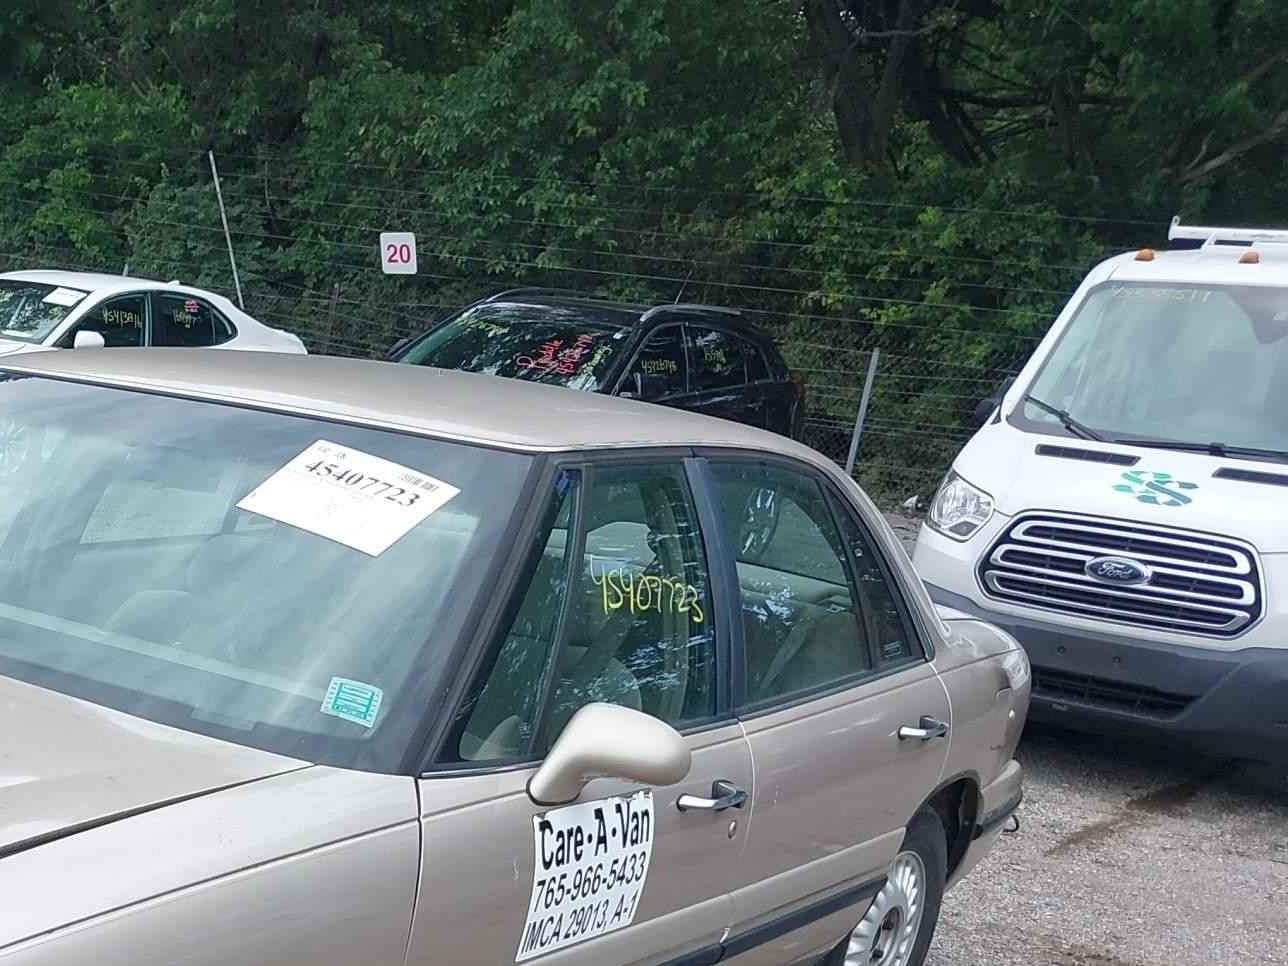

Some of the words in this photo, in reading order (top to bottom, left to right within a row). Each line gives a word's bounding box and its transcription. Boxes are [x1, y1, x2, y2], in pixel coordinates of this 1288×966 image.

[386, 243, 411, 264] 20
[103, 307, 143, 329] 45413816
[305, 460, 421, 507] 45407723
[590, 554, 703, 623] 45407723
[1097, 561, 1133, 579] Ford
[534, 850, 647, 913] 765-966-5433
[520, 913, 564, 954] IMCA
[611, 889, 639, 925] A-1
